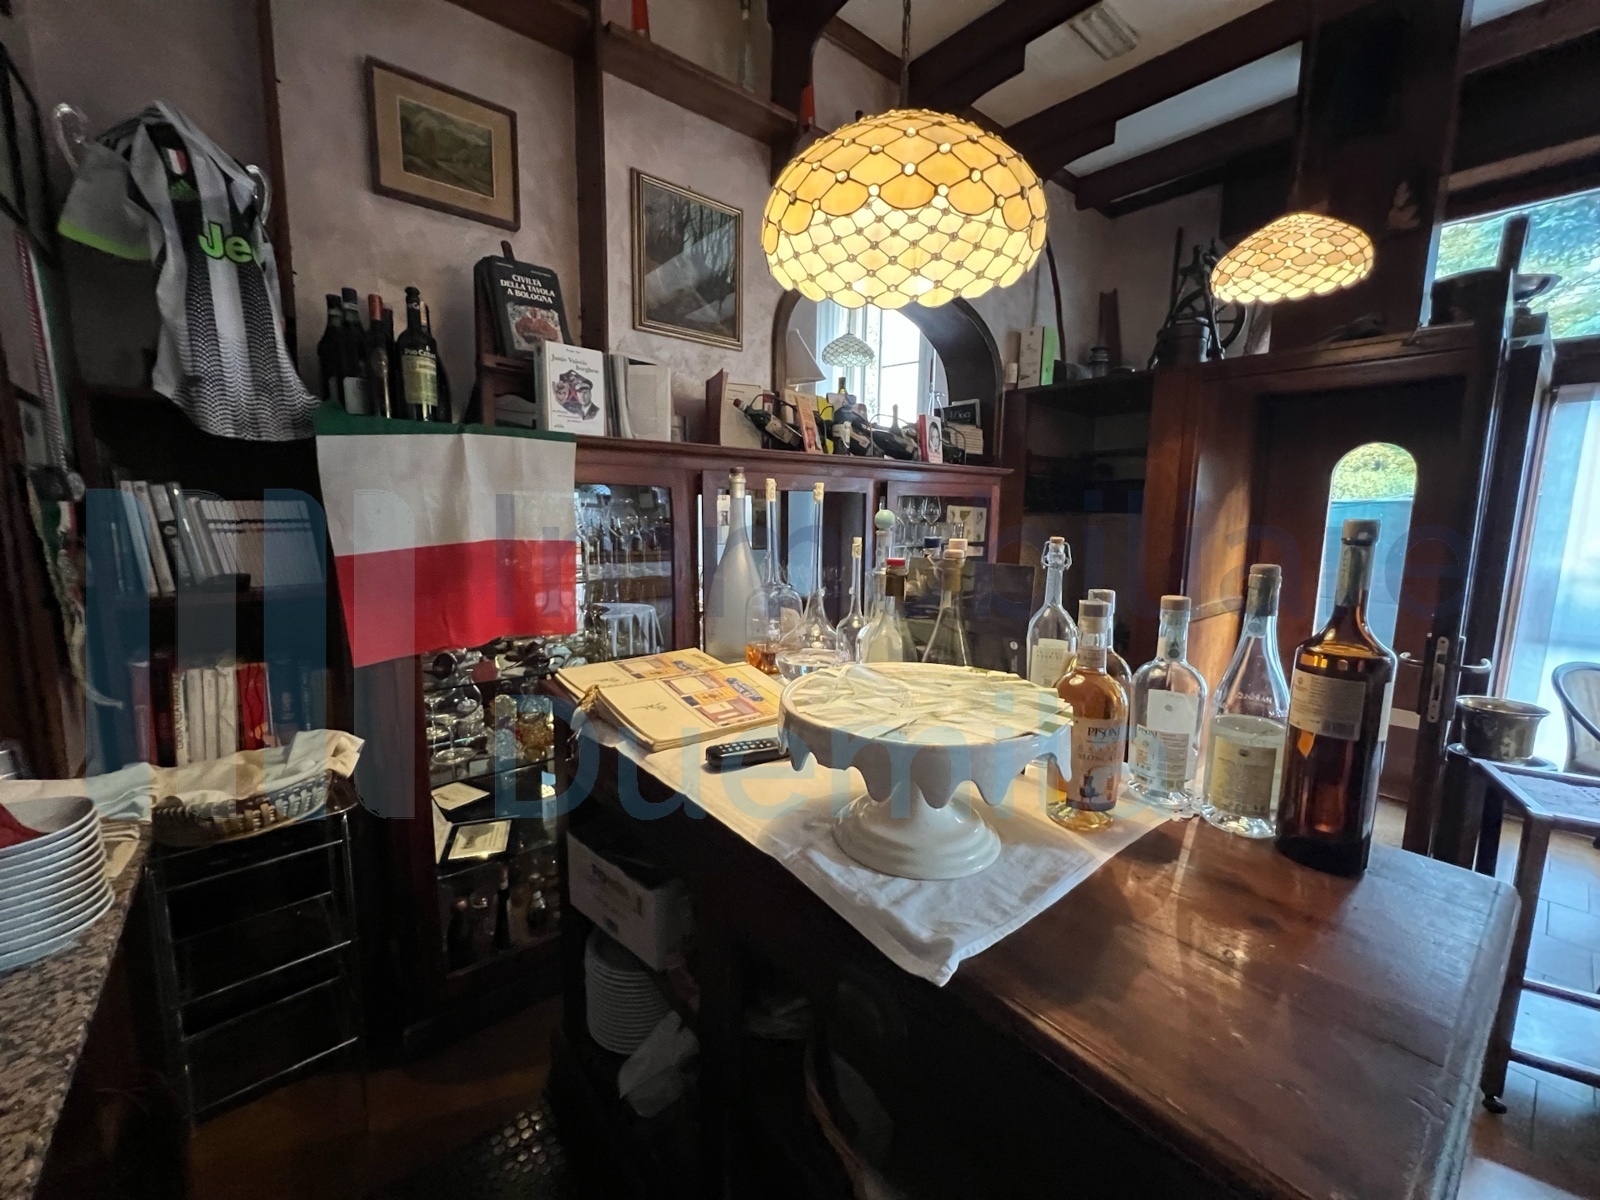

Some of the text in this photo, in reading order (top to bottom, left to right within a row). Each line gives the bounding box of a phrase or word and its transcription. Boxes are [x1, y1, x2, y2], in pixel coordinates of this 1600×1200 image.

[500, 279, 556, 298] DELLA TAVOLA
[507, 288, 554, 304] A BOLOGNA
[1088, 726, 1121, 740] PISONI
